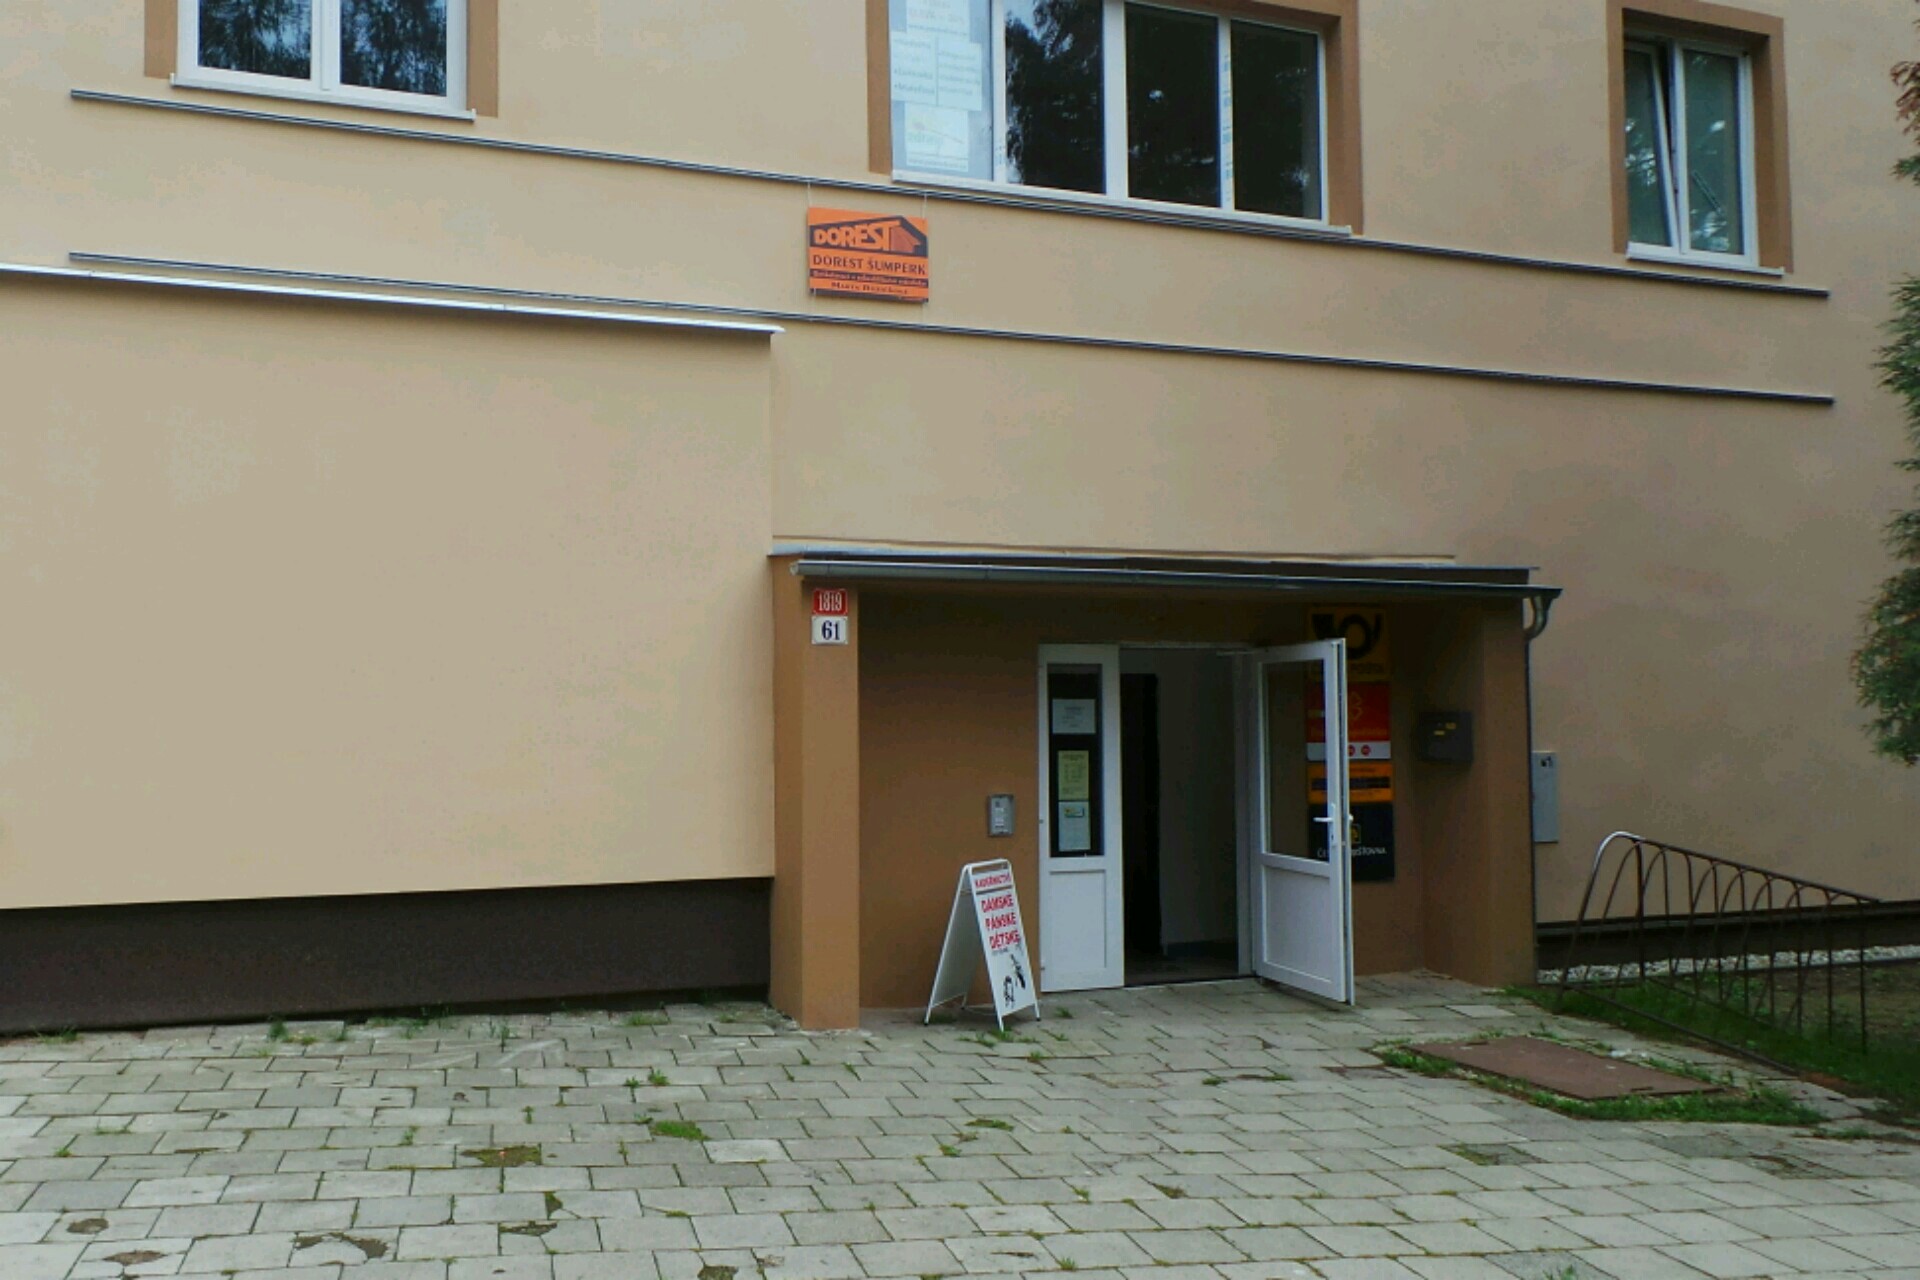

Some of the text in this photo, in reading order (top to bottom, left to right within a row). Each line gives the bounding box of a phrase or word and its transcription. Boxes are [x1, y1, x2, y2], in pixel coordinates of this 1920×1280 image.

[814, 220, 900, 251] DOREST
[813, 254, 926, 276] DOREST ŠUMPERK
[819, 592, 842, 612] 1819
[821, 620, 840, 641] 61
